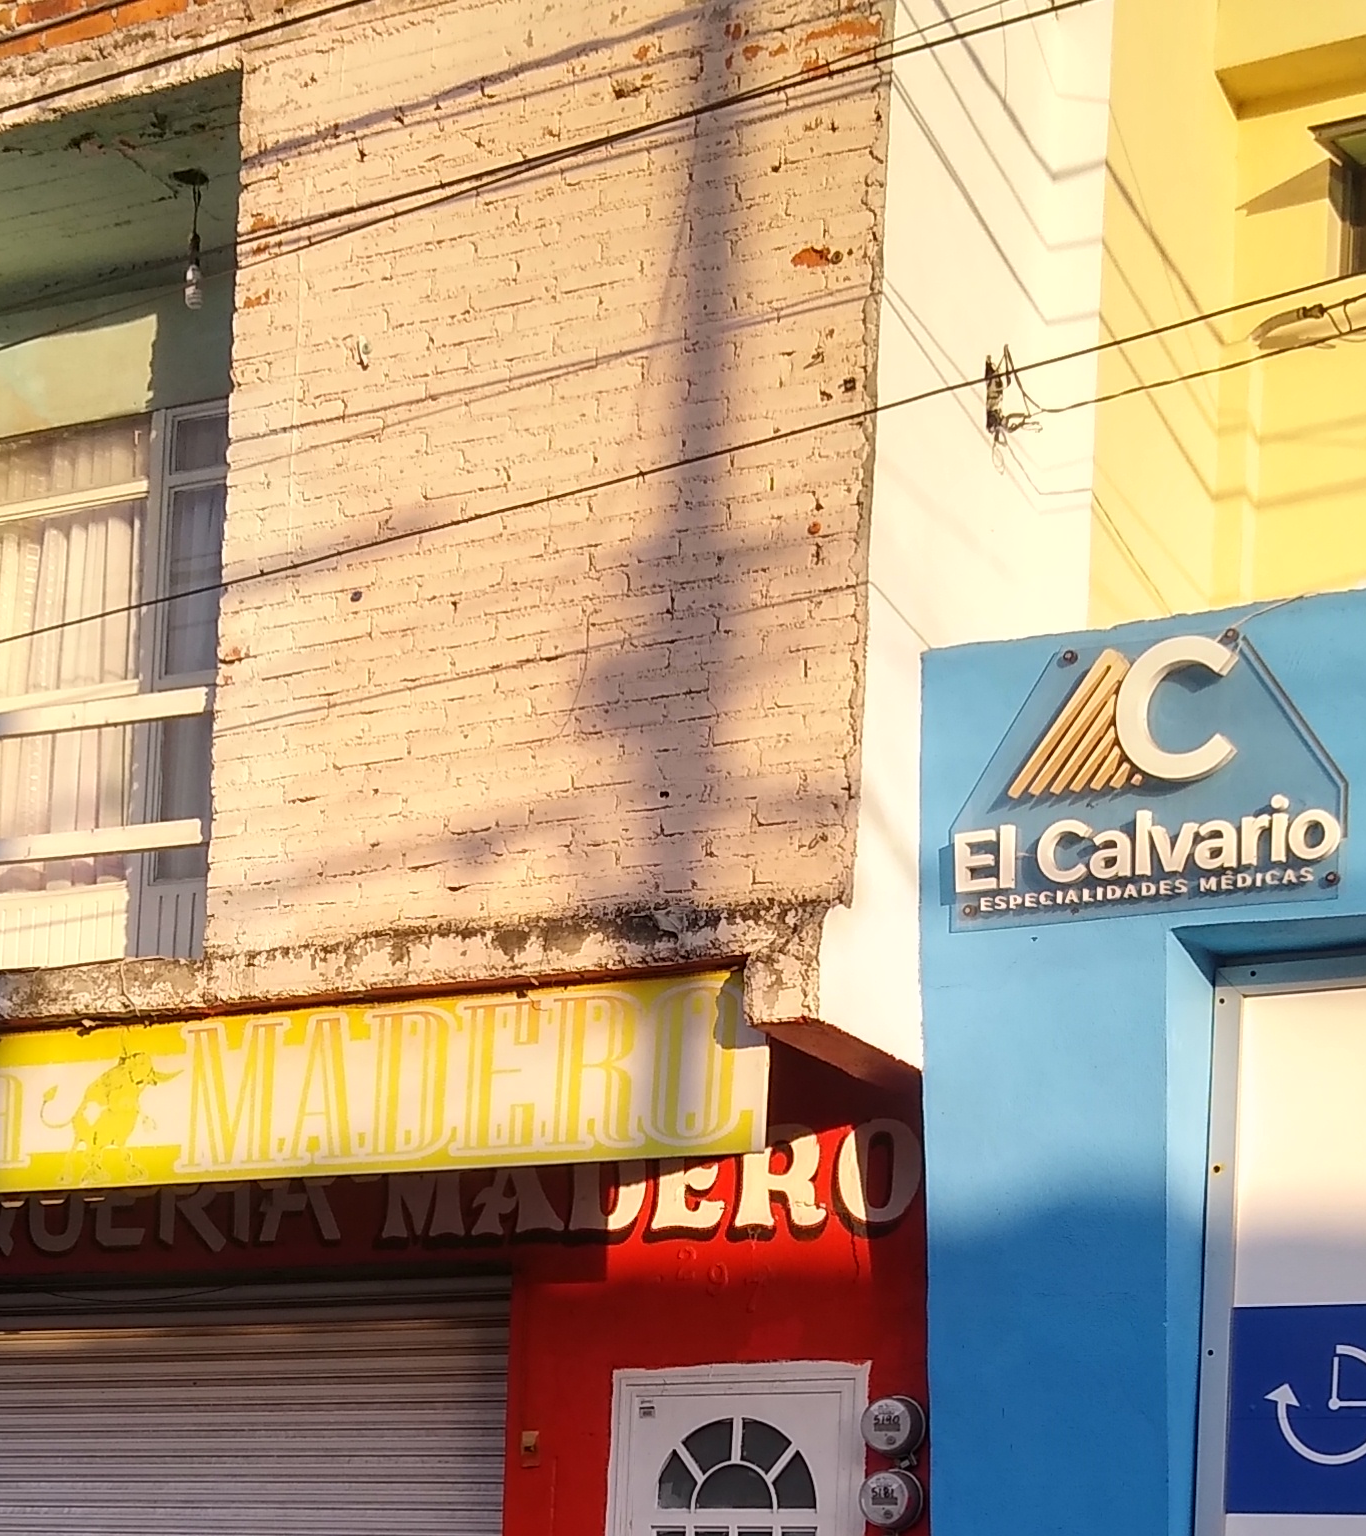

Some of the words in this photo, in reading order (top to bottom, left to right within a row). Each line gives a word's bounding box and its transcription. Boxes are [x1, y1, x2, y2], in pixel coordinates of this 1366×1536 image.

[954, 824, 1017, 893] El
[1037, 794, 1341, 884] Calvario
[980, 879, 1188, 912] ESPECIALIDADES
[1199, 866, 1315, 893] MÉDICAS
[175, 980, 743, 1172] MADERO
[381, 1118, 921, 1240] MADERO
